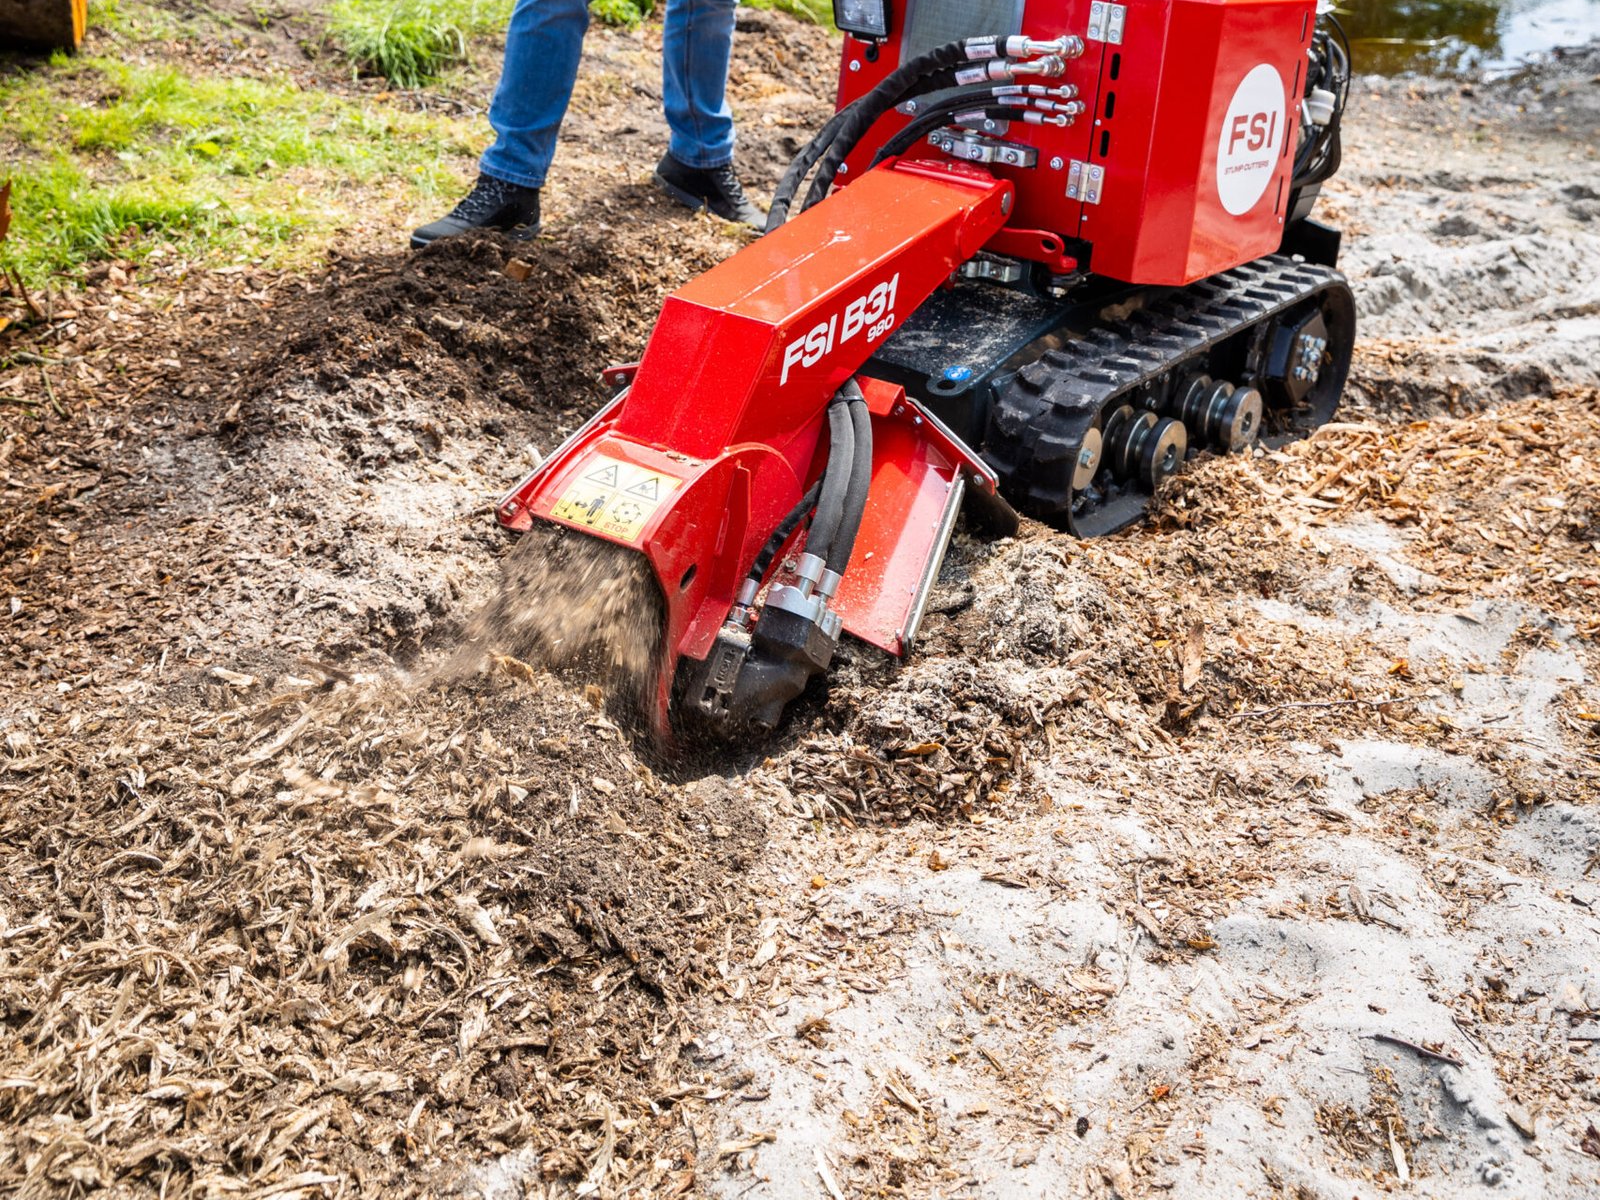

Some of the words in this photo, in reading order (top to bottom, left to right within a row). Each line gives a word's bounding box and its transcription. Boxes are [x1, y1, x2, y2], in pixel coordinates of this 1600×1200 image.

[1228, 111, 1277, 155] FSI
[780, 313, 838, 387] FSI
[840, 272, 900, 344] B31
[867, 313, 895, 343] 980
[603, 521, 629, 534] STOP
